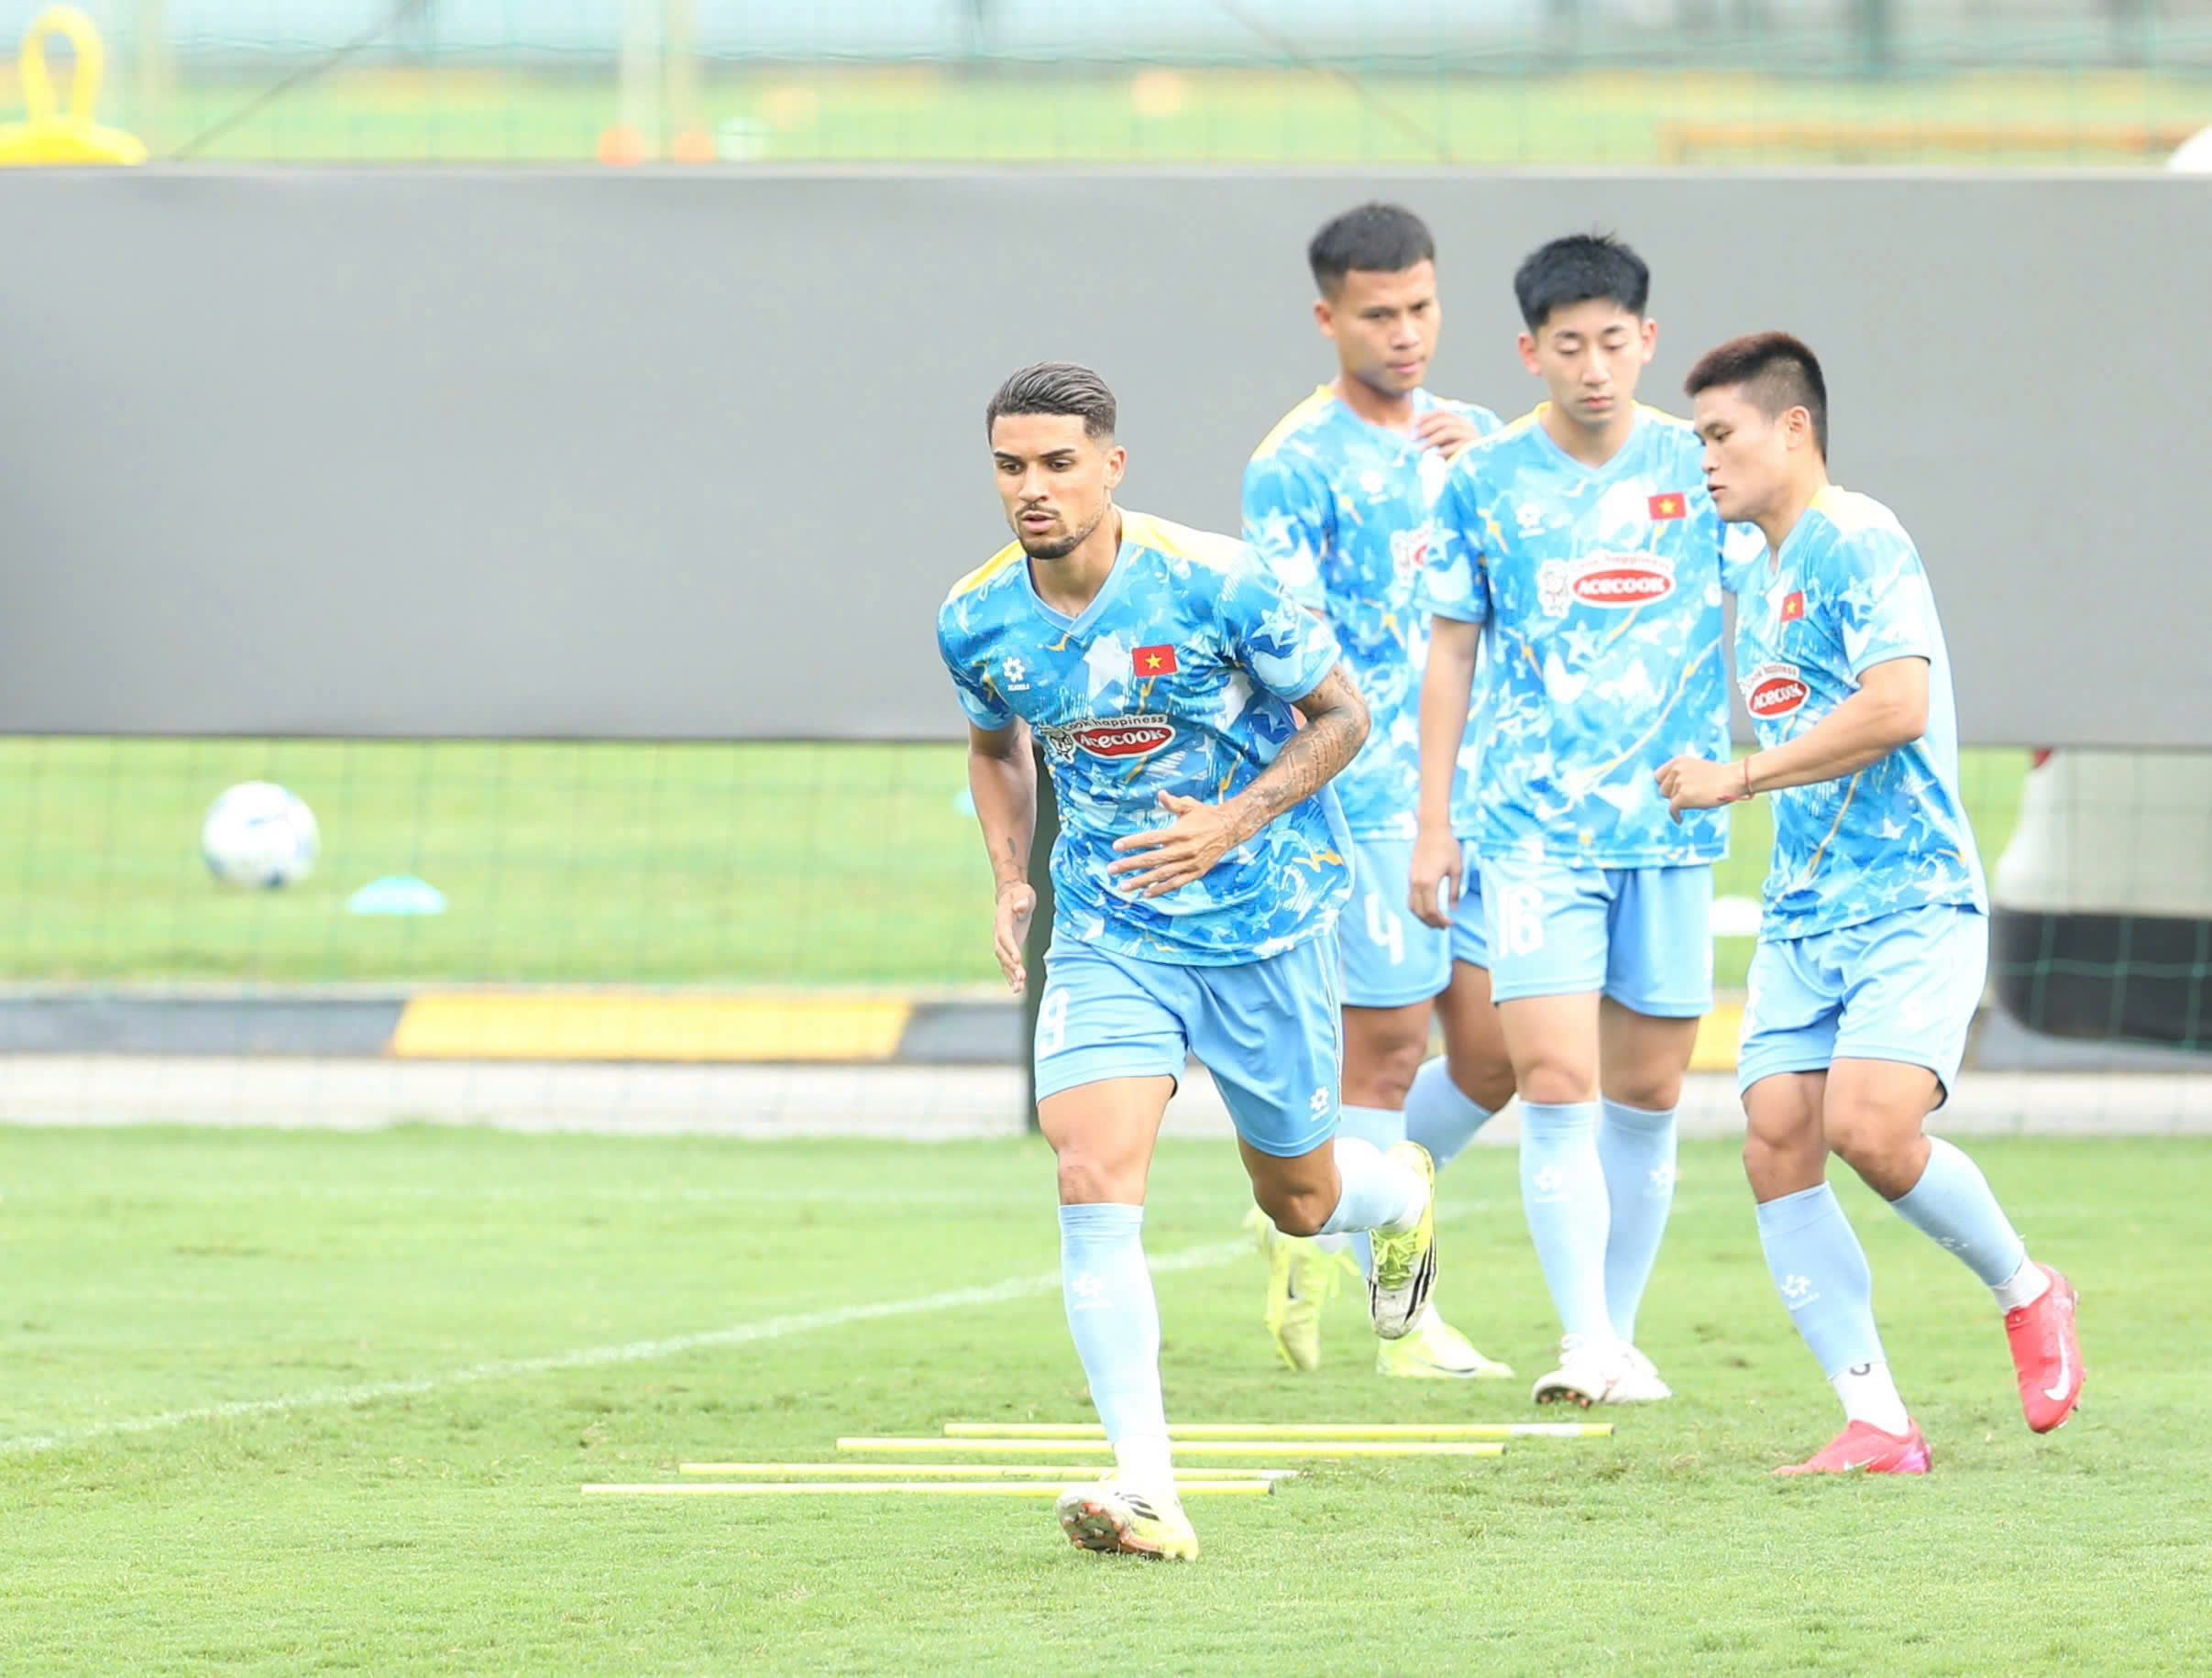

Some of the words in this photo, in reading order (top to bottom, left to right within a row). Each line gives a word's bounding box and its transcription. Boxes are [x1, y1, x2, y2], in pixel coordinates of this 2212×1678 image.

[1093, 715, 1165, 727] happiness
[1364, 890, 1404, 966] 4
[1497, 886, 1545, 956] 18
[1040, 987, 1071, 1054] 9
